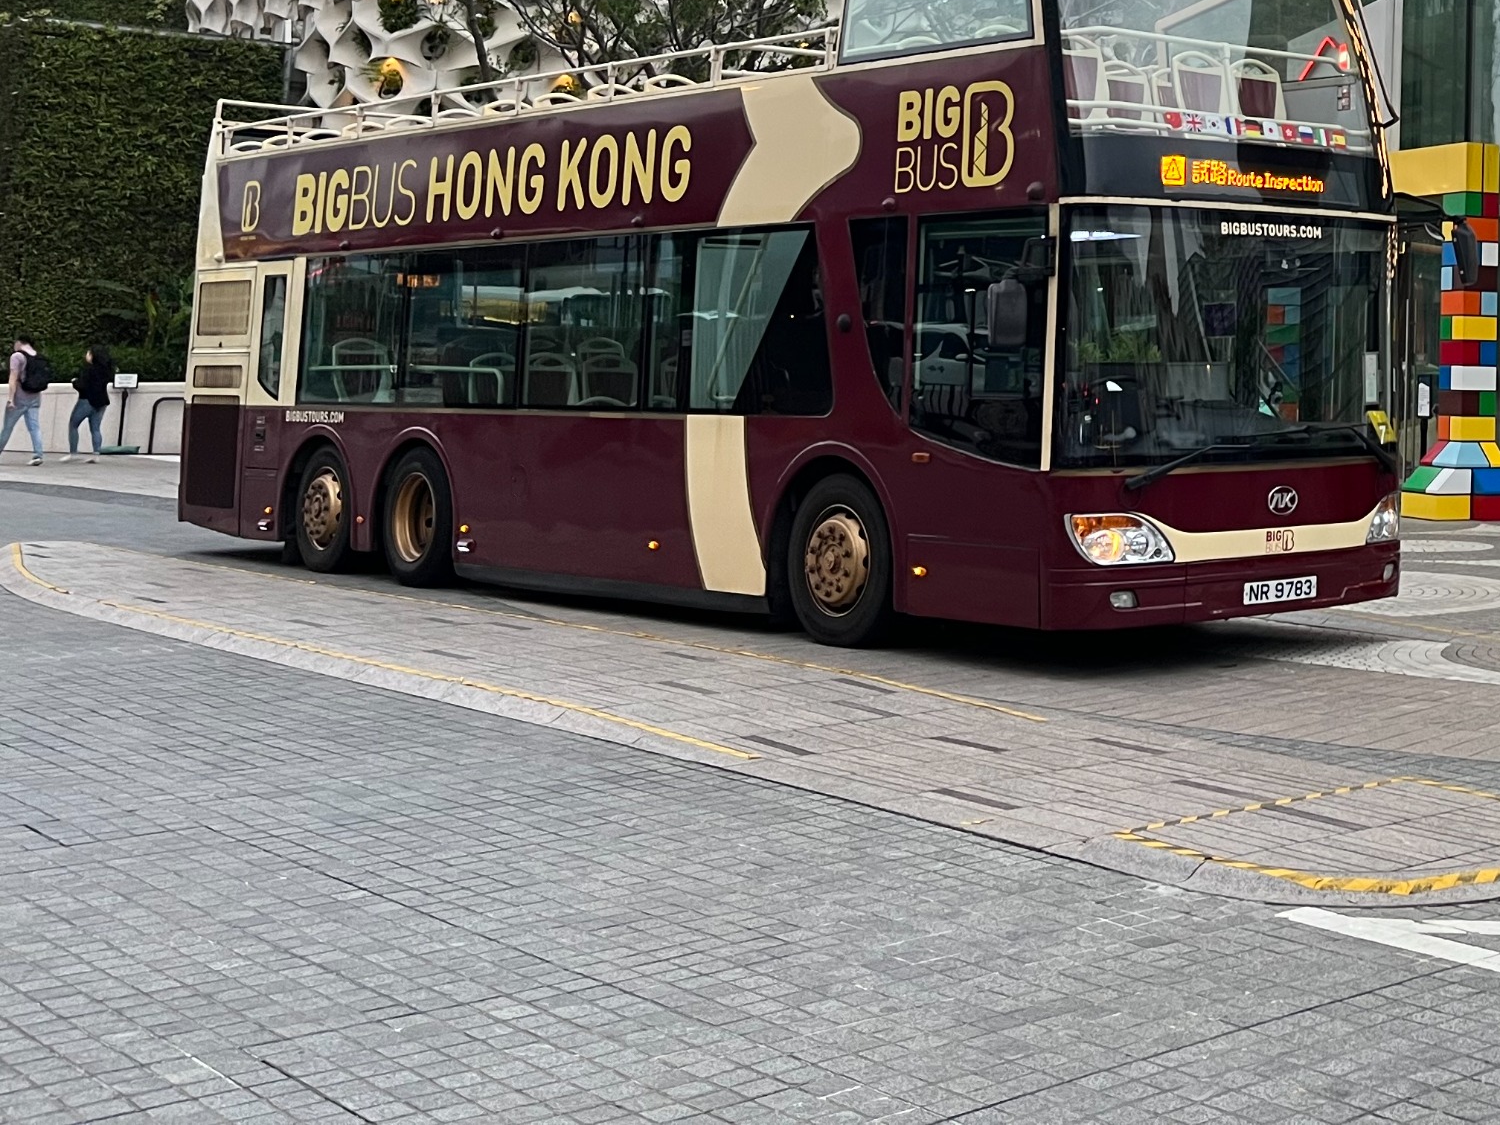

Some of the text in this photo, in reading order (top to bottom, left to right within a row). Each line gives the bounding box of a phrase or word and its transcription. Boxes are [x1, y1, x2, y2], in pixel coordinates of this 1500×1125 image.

[897, 85, 961, 142] BIG
[426, 142, 546, 223] HONG
[557, 125, 692, 212] KONG
[895, 143, 958, 193] BUS
[1192, 160, 1324, 193] 試路 Route Inspection
[1221, 222, 1322, 239] BIGBUSTOURS.COM
[285, 410, 345, 423] BIGBUSTOURS.COM
[1266, 530, 1282, 542] BIG
[1248, 579, 1312, 601] NR 9783
